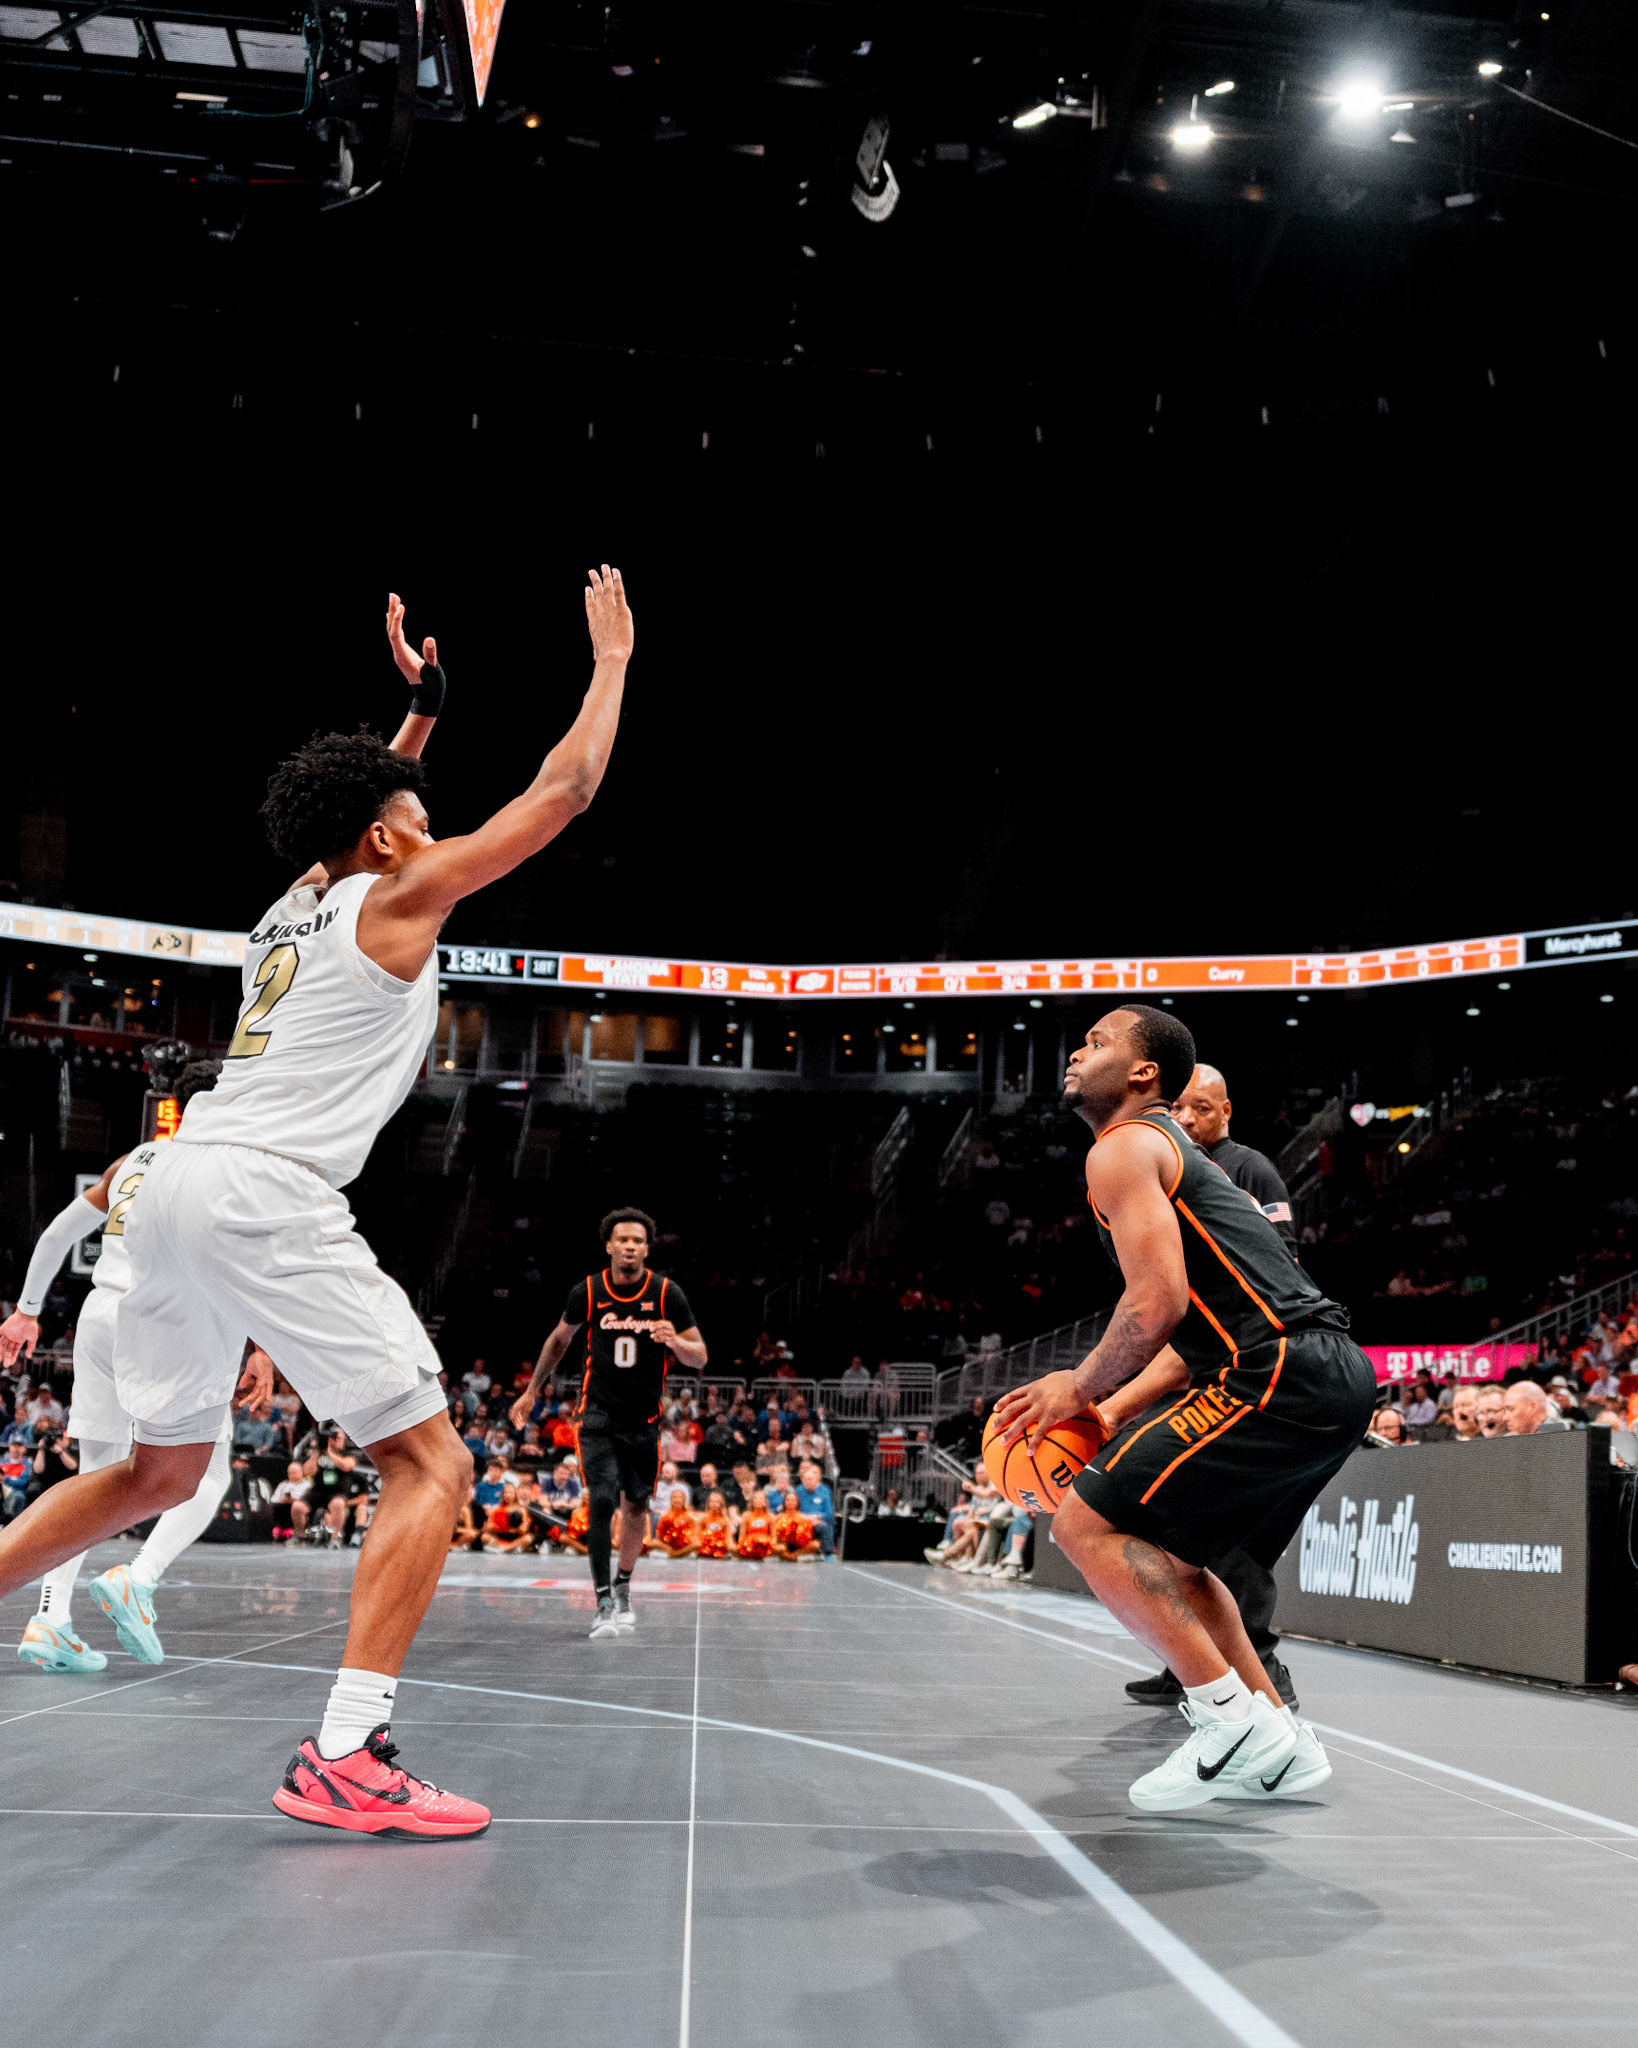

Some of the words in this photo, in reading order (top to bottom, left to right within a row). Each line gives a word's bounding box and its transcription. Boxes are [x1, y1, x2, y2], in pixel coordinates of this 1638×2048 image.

[1545, 931, 1622, 955] Mercyhurst
[447, 949, 512, 975] 13:41
[1147, 968, 1157, 981] 0
[1208, 966, 1245, 982] Curry
[1348, 969, 1359, 985] 0
[1418, 961, 1429, 977] 0
[1452, 957, 1463, 973] 0
[1489, 953, 1501, 969] 0
[700, 967, 728, 990] 13
[223, 941, 300, 1060] 2
[600, 1312, 653, 1334] Cowboys
[614, 1336, 637, 1368] 0
[1299, 1496, 1358, 1597] Charlie
[1355, 1494, 1420, 1605] Hustle
[1448, 1541, 1562, 1574] CHARLIEHUSTLE.COM
